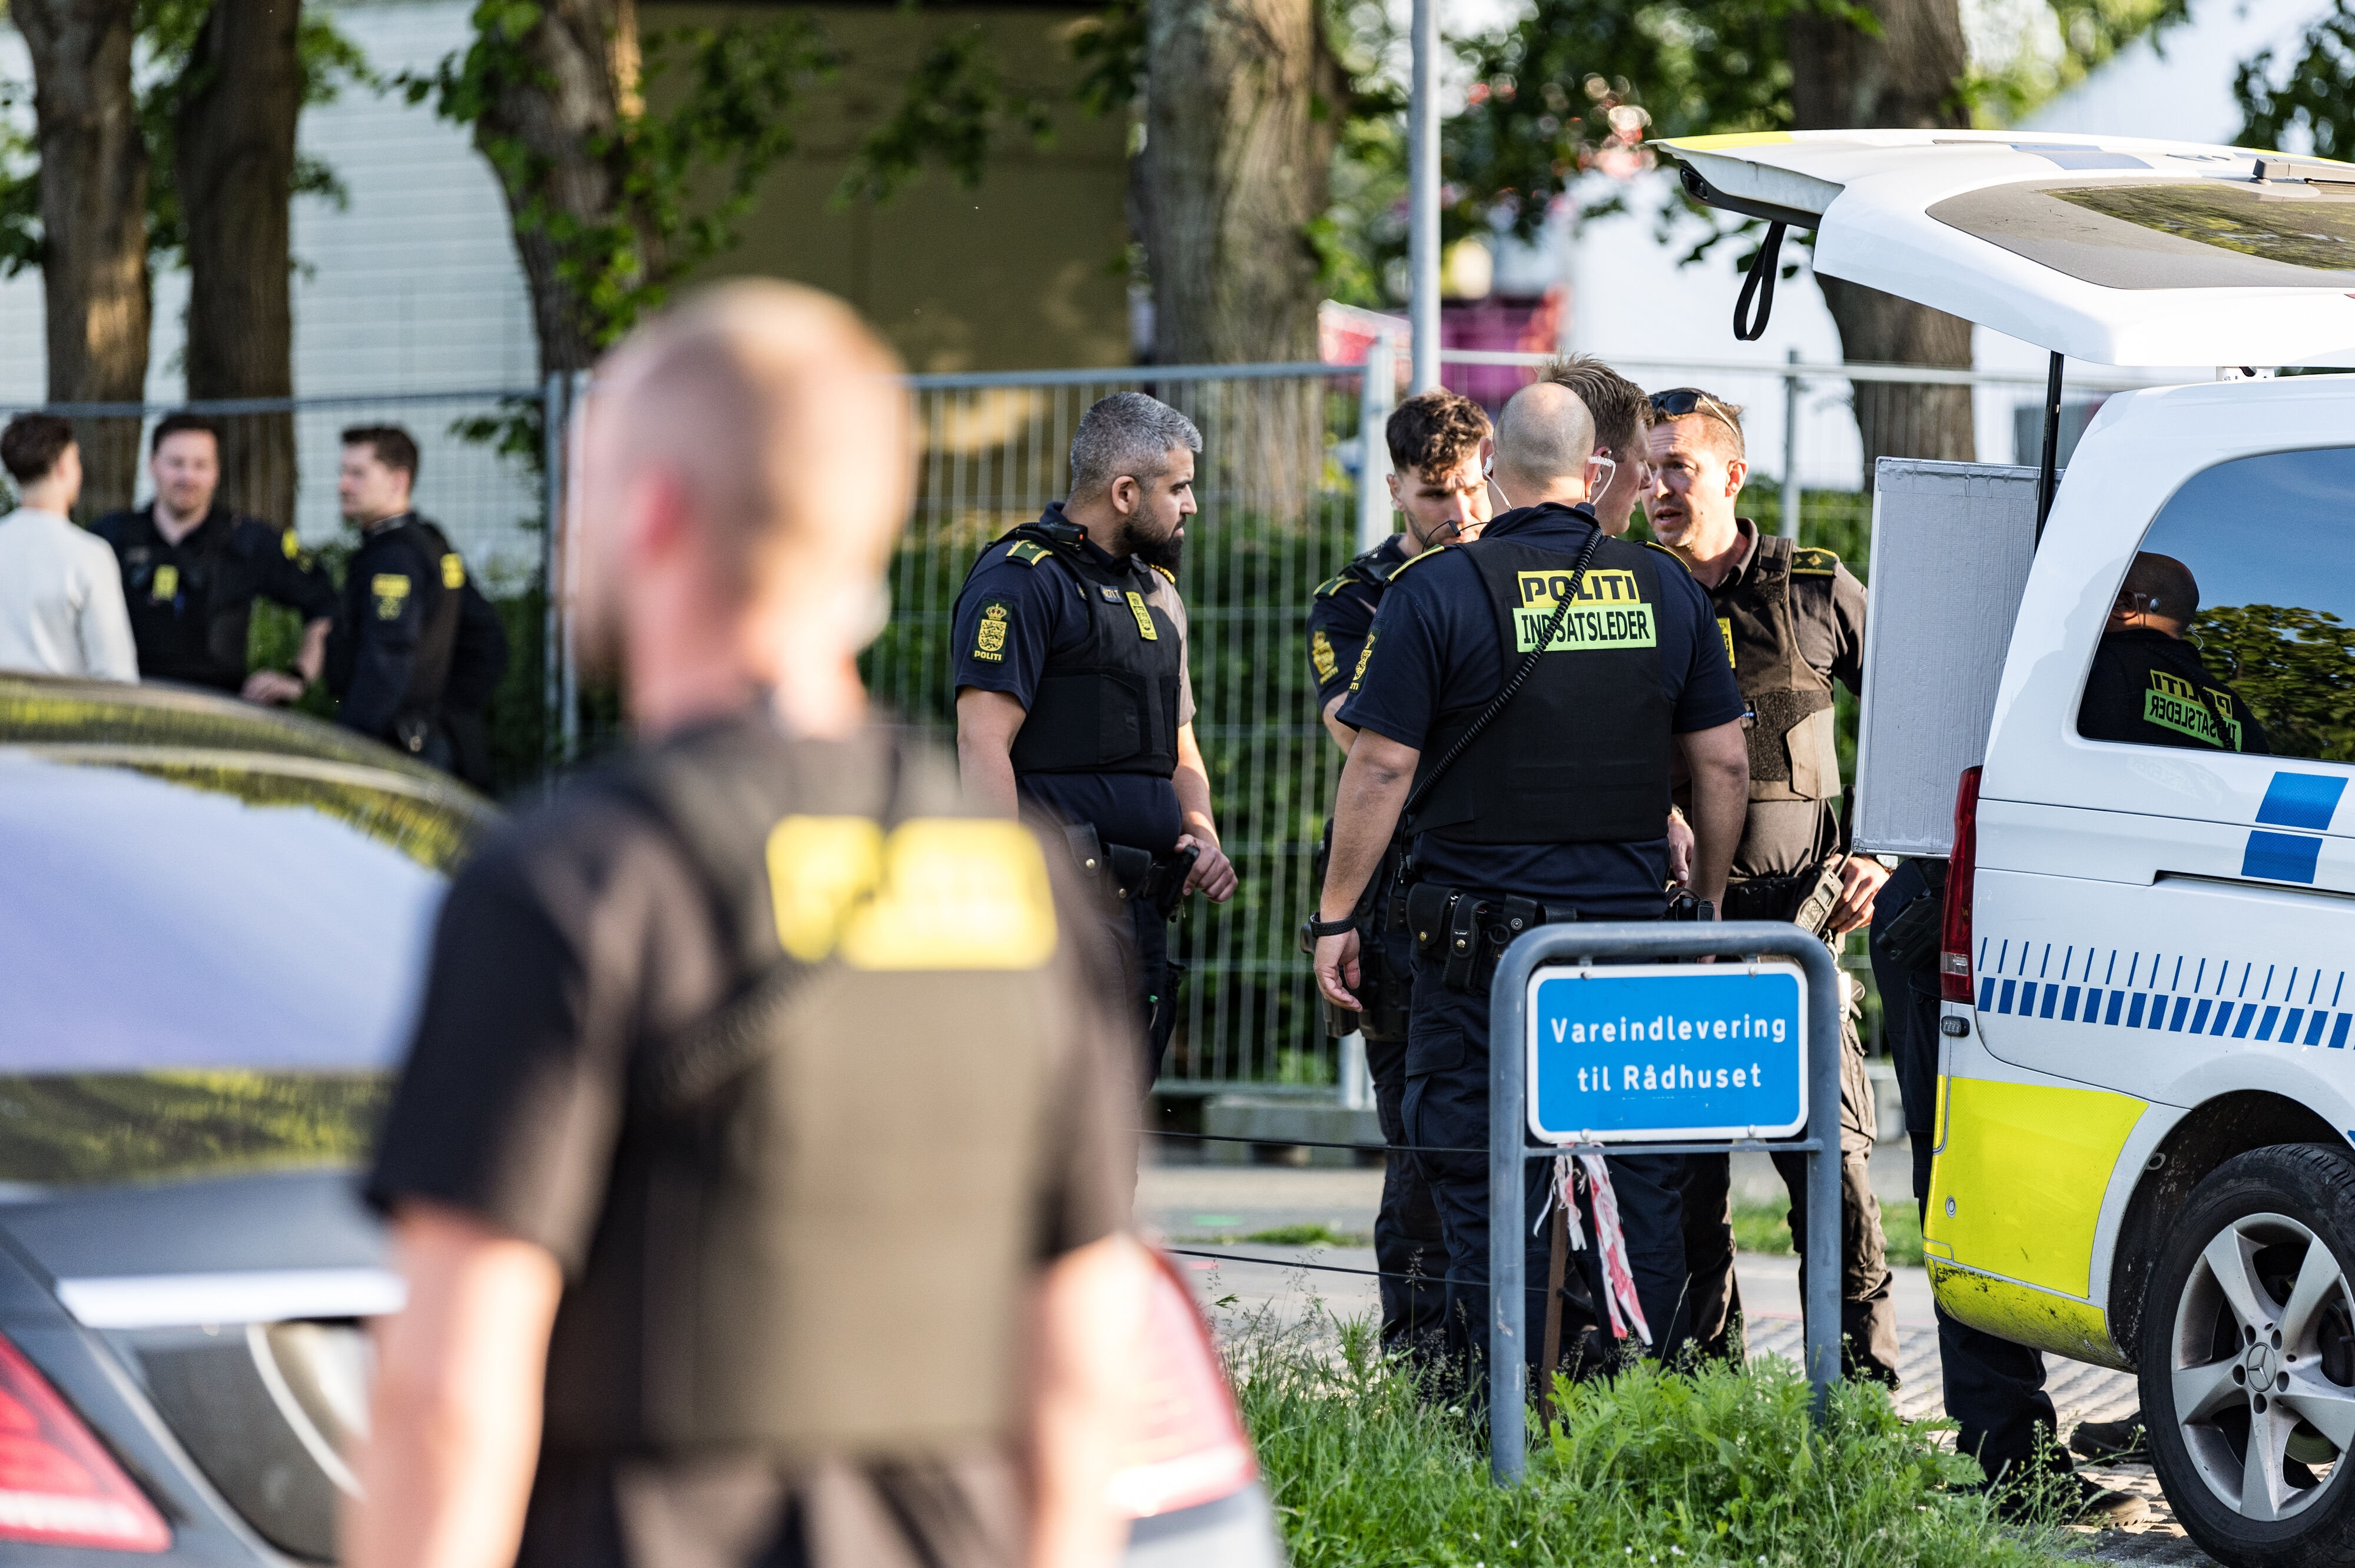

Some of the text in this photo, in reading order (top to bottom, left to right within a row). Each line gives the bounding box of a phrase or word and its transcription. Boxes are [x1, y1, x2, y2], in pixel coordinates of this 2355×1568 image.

[1521, 576, 1636, 602] POLITI
[1521, 610, 1650, 644] INDSATSLEDER
[974, 650, 1001, 660] POLITI
[1551, 1014, 1786, 1043] Vareindlevering
[1577, 1062, 1762, 1092] til Rådhuset
